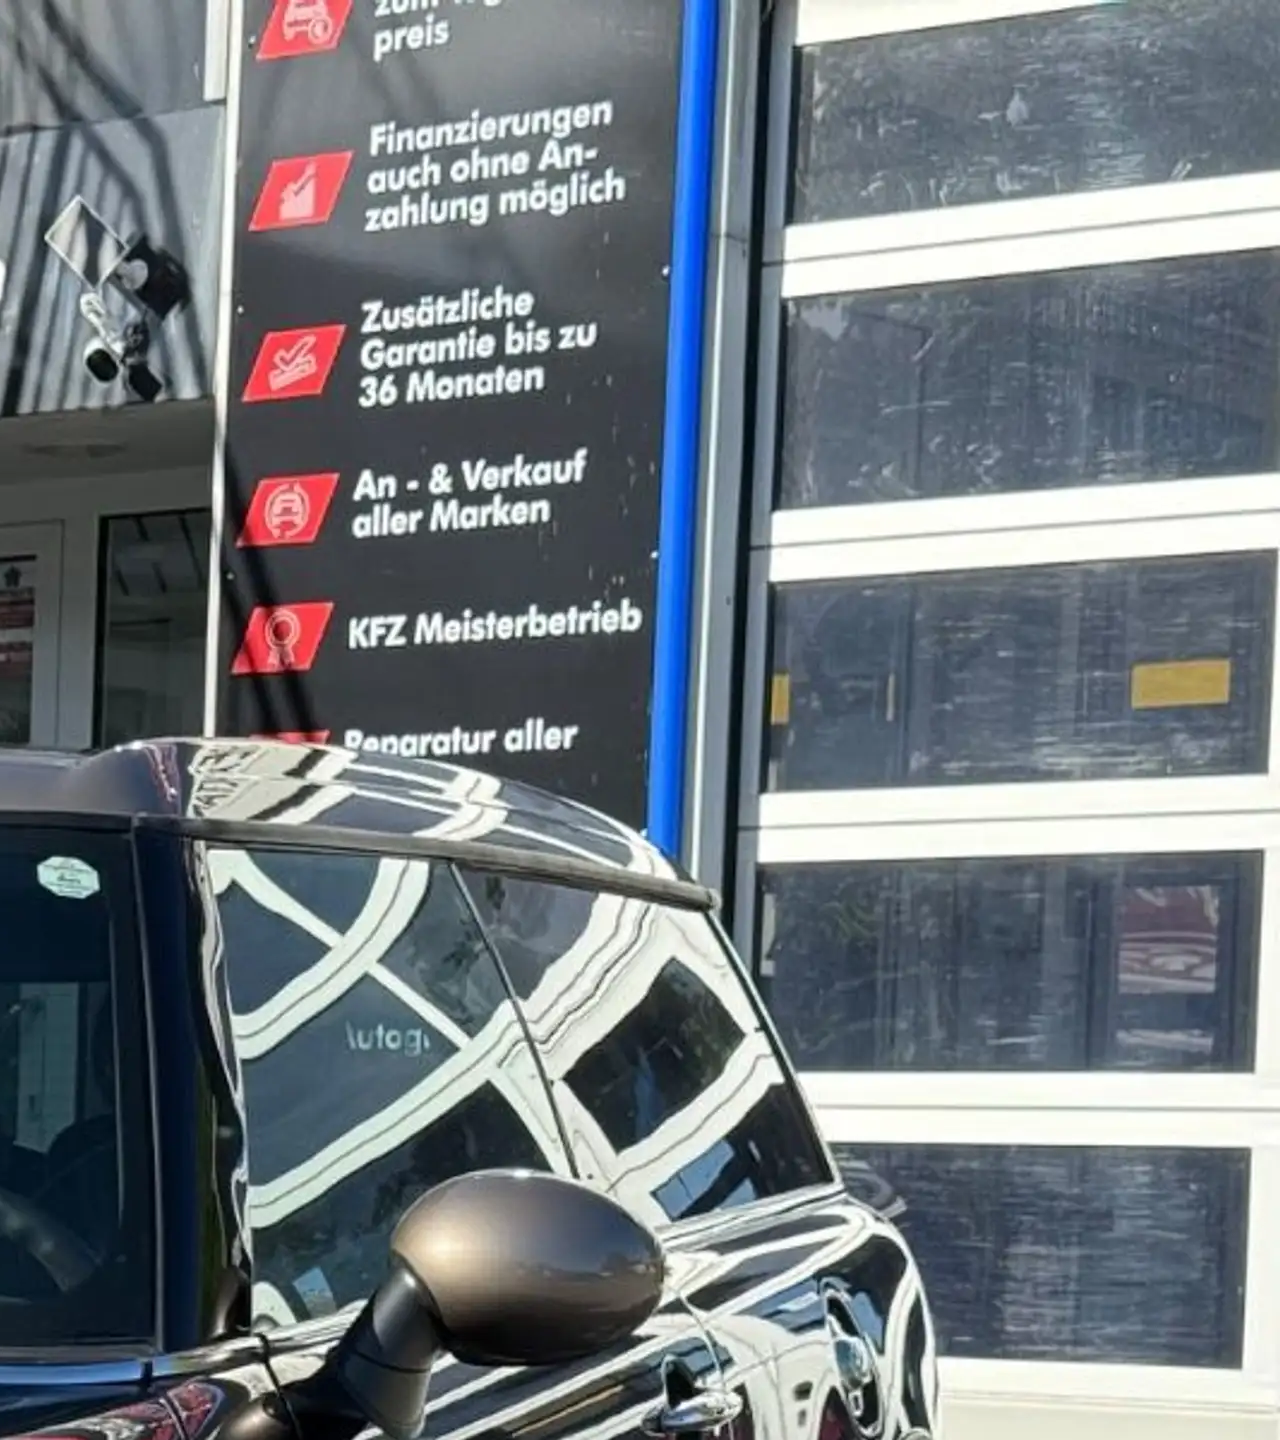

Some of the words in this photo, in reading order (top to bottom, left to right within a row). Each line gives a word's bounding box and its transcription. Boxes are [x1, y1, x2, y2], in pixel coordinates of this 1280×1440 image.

[373, 12, 450, 62] preis
[369, 101, 613, 157] Finanzierungen
[366, 155, 440, 194] auch
[451, 149, 529, 184] ohne
[538, 140, 598, 170] An-
[364, 189, 488, 233] zahlung
[498, 168, 627, 215] möglich
[360, 286, 534, 334] Zusätzliche
[360, 327, 494, 371] Garantie
[504, 321, 551, 355] bis
[557, 320, 597, 350] zu
[358, 373, 398, 408] 36
[406, 363, 545, 402] Monaten
[353, 468, 397, 501] An
[462, 447, 588, 491] Verkauf
[352, 501, 423, 538] aller
[430, 495, 551, 532] Marken
[348, 615, 407, 649] KFZ
[414, 597, 643, 645] Meisterbetrieb
[504, 717, 579, 752] aller
